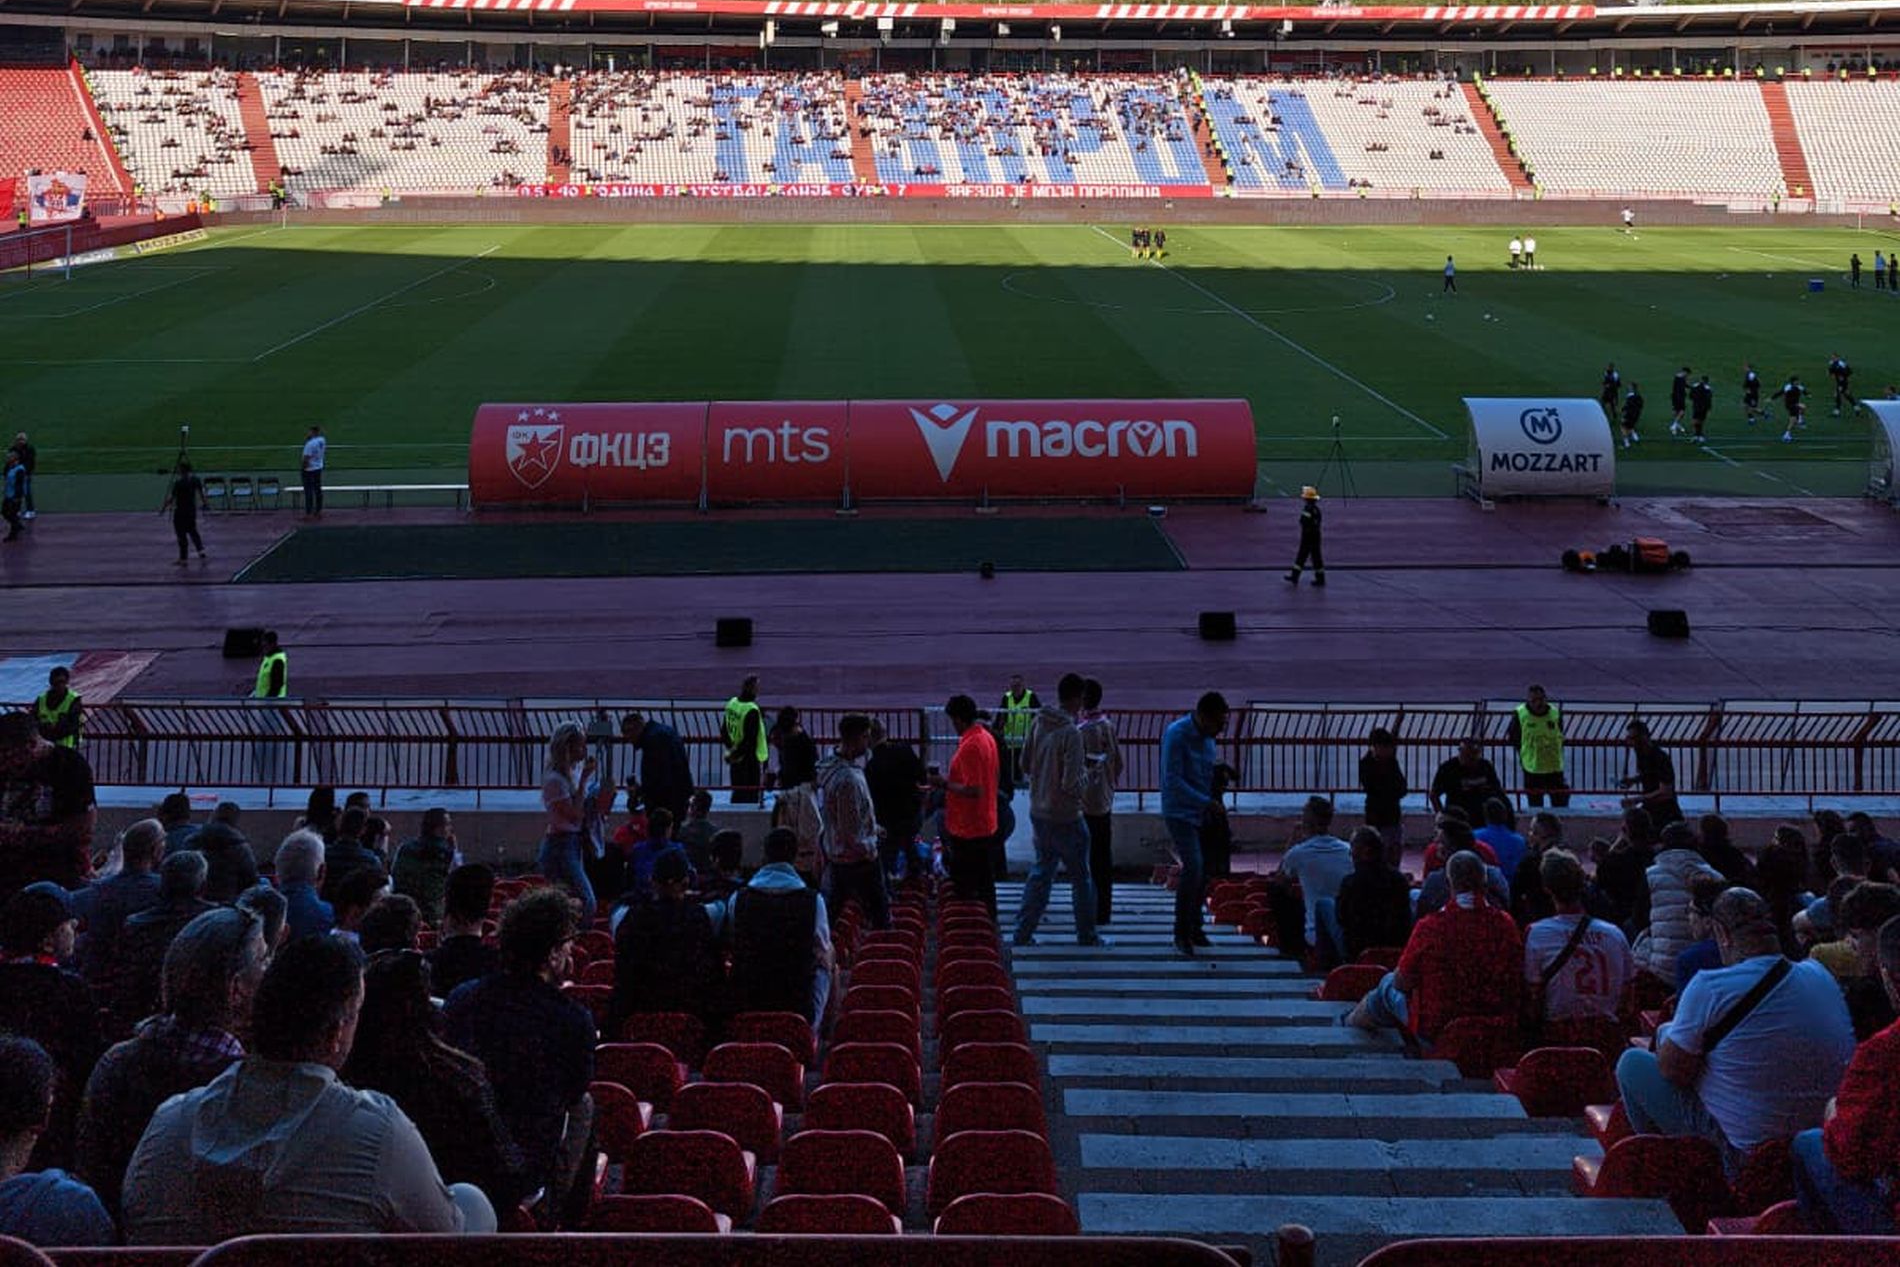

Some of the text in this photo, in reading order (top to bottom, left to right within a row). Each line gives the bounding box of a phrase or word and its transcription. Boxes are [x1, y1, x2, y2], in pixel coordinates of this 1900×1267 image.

[569, 432, 670, 470] ФКЦЗ
[723, 420, 830, 463] mts
[985, 419, 1198, 458] macron
[1491, 453, 1602, 472] MOZZART
